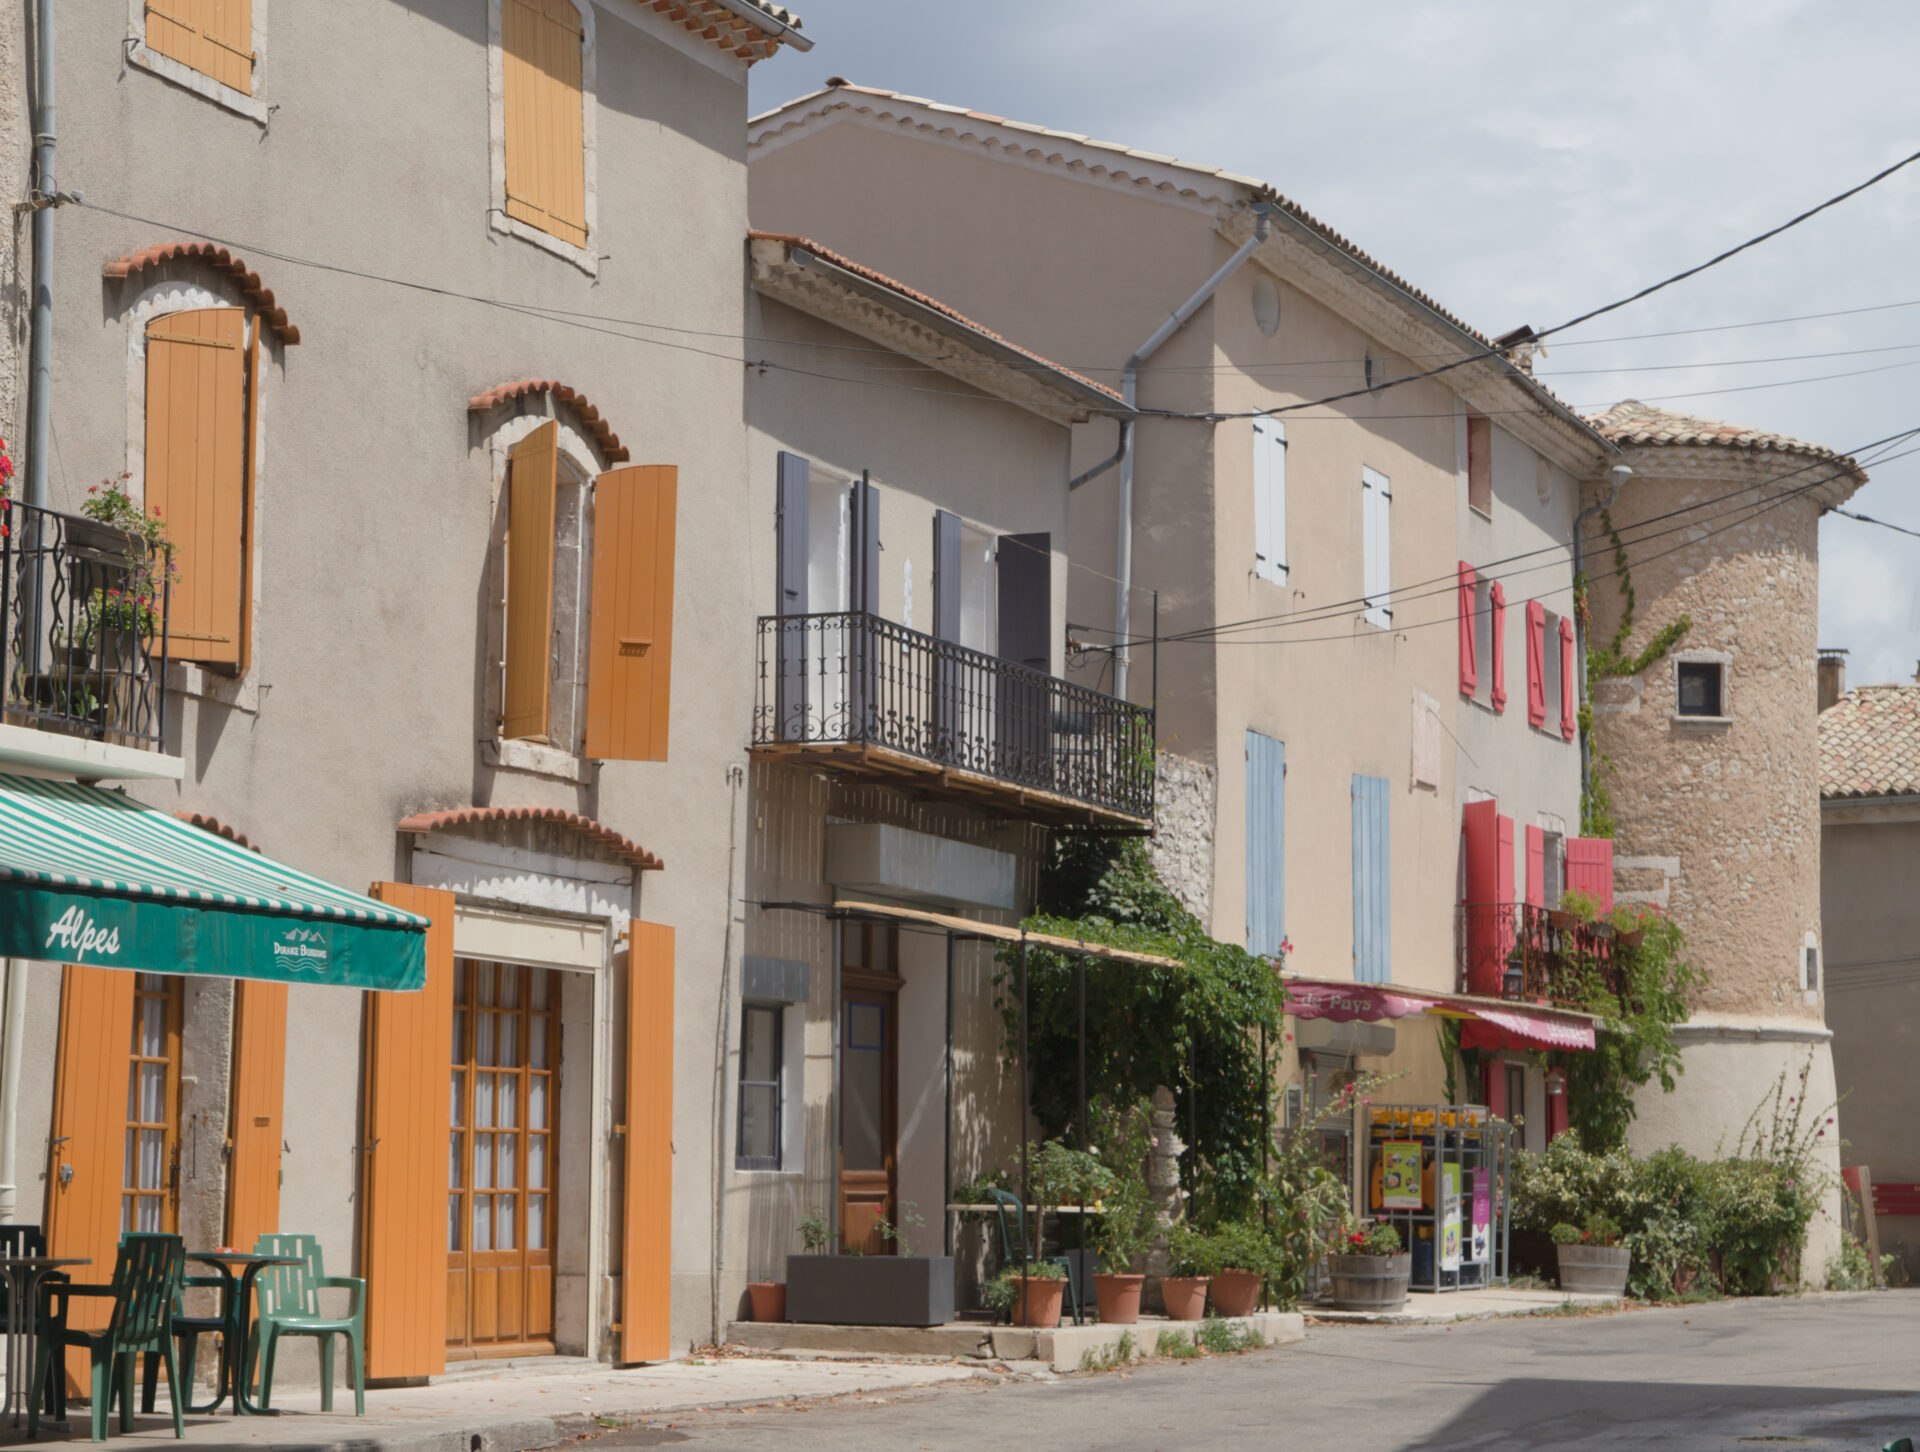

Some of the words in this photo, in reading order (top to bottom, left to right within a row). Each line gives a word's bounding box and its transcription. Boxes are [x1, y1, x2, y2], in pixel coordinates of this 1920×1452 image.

[45, 905, 120, 962] Alpes
[1301, 992, 1322, 1008] de
[1329, 993, 1373, 1014] Pays
